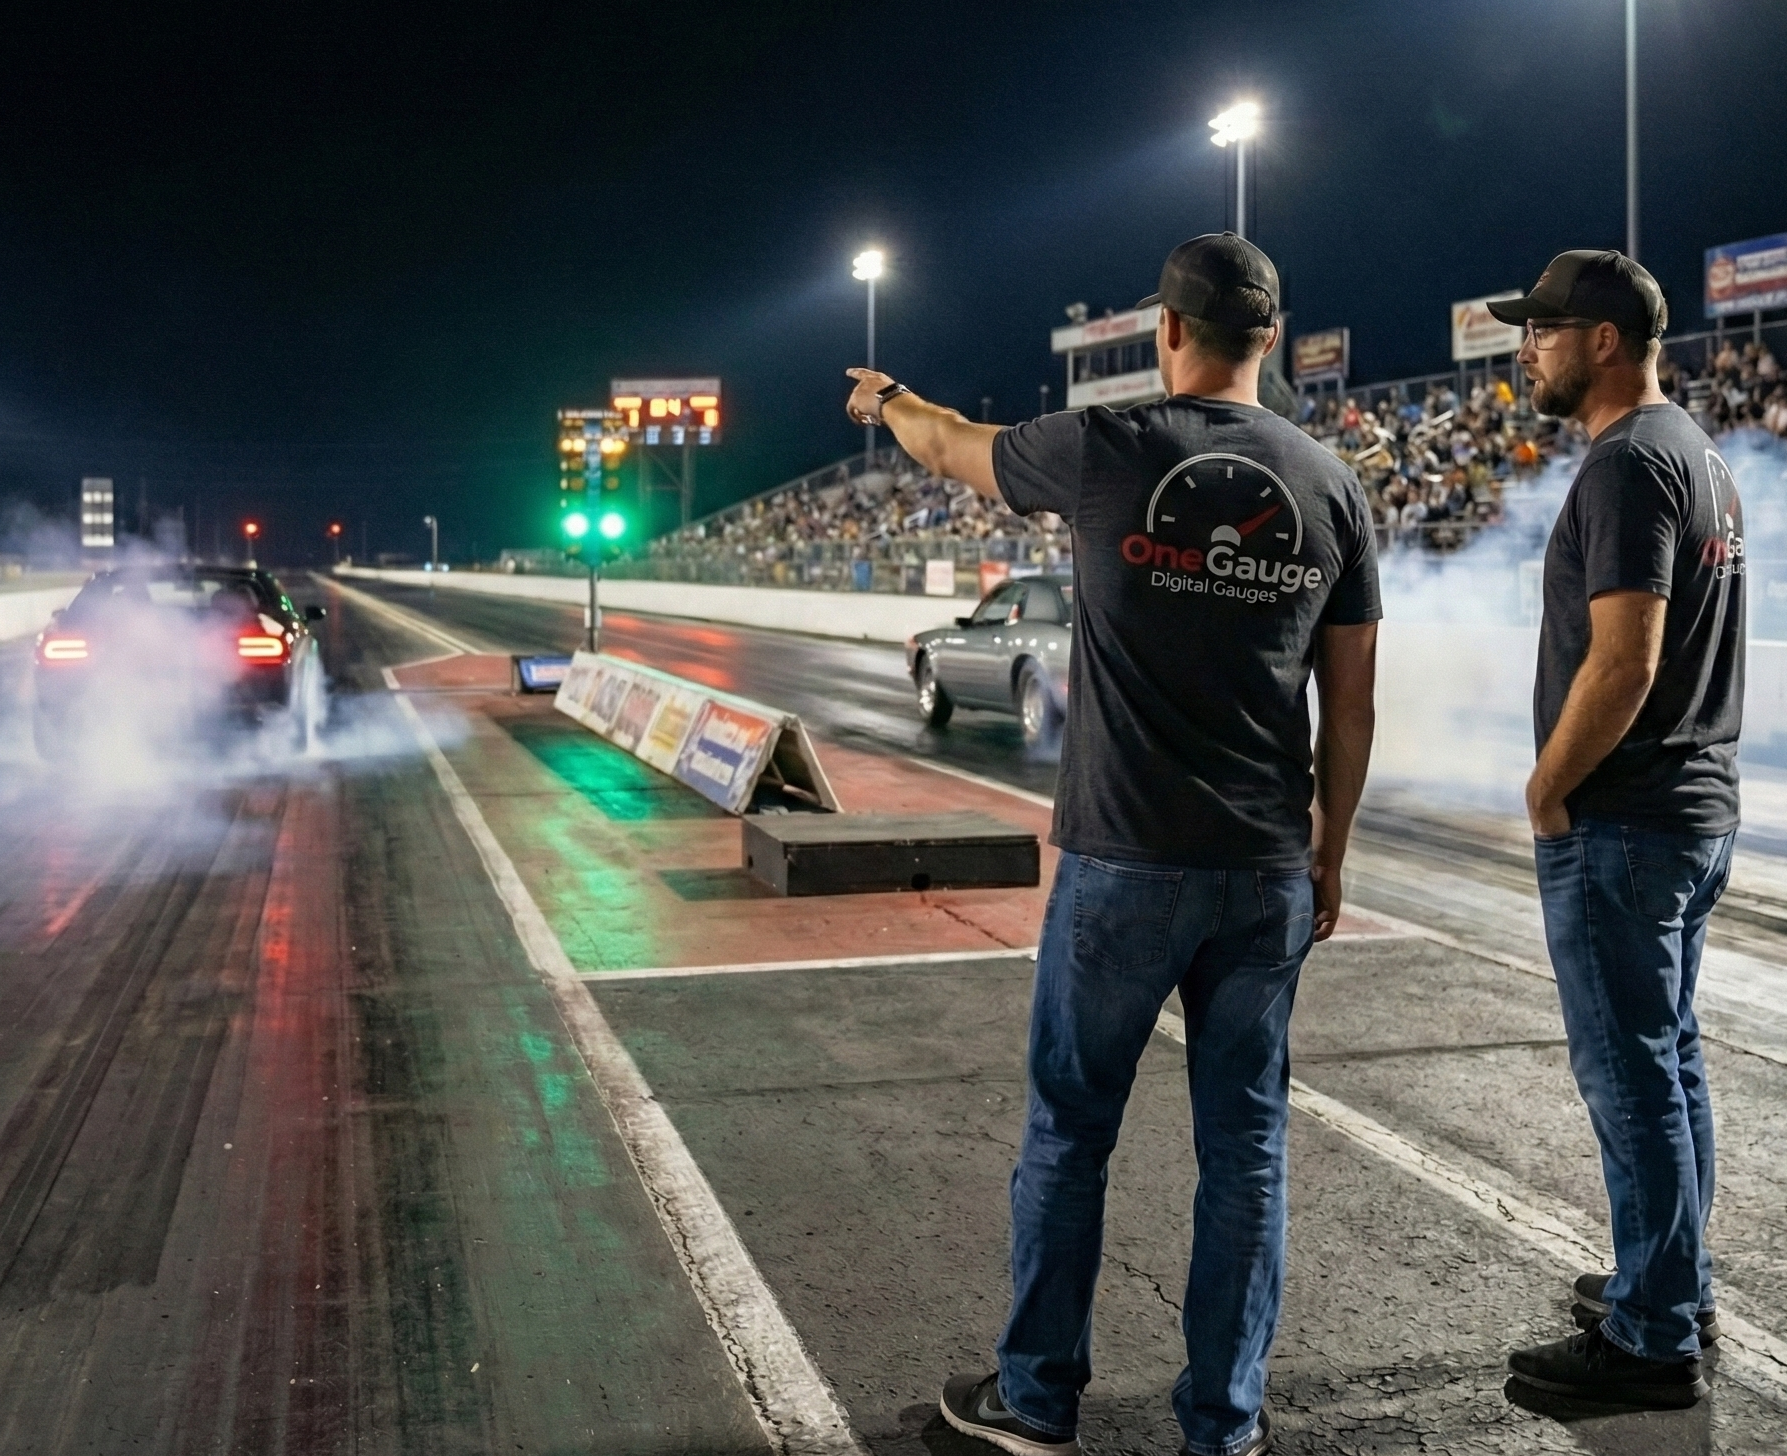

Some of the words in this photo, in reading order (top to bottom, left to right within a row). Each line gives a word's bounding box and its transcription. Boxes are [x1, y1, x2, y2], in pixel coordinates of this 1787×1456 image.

[1121, 534, 1322, 593] OneGauge
[1151, 571, 1208, 593] Digital
[1213, 581, 1278, 604] Gauges
